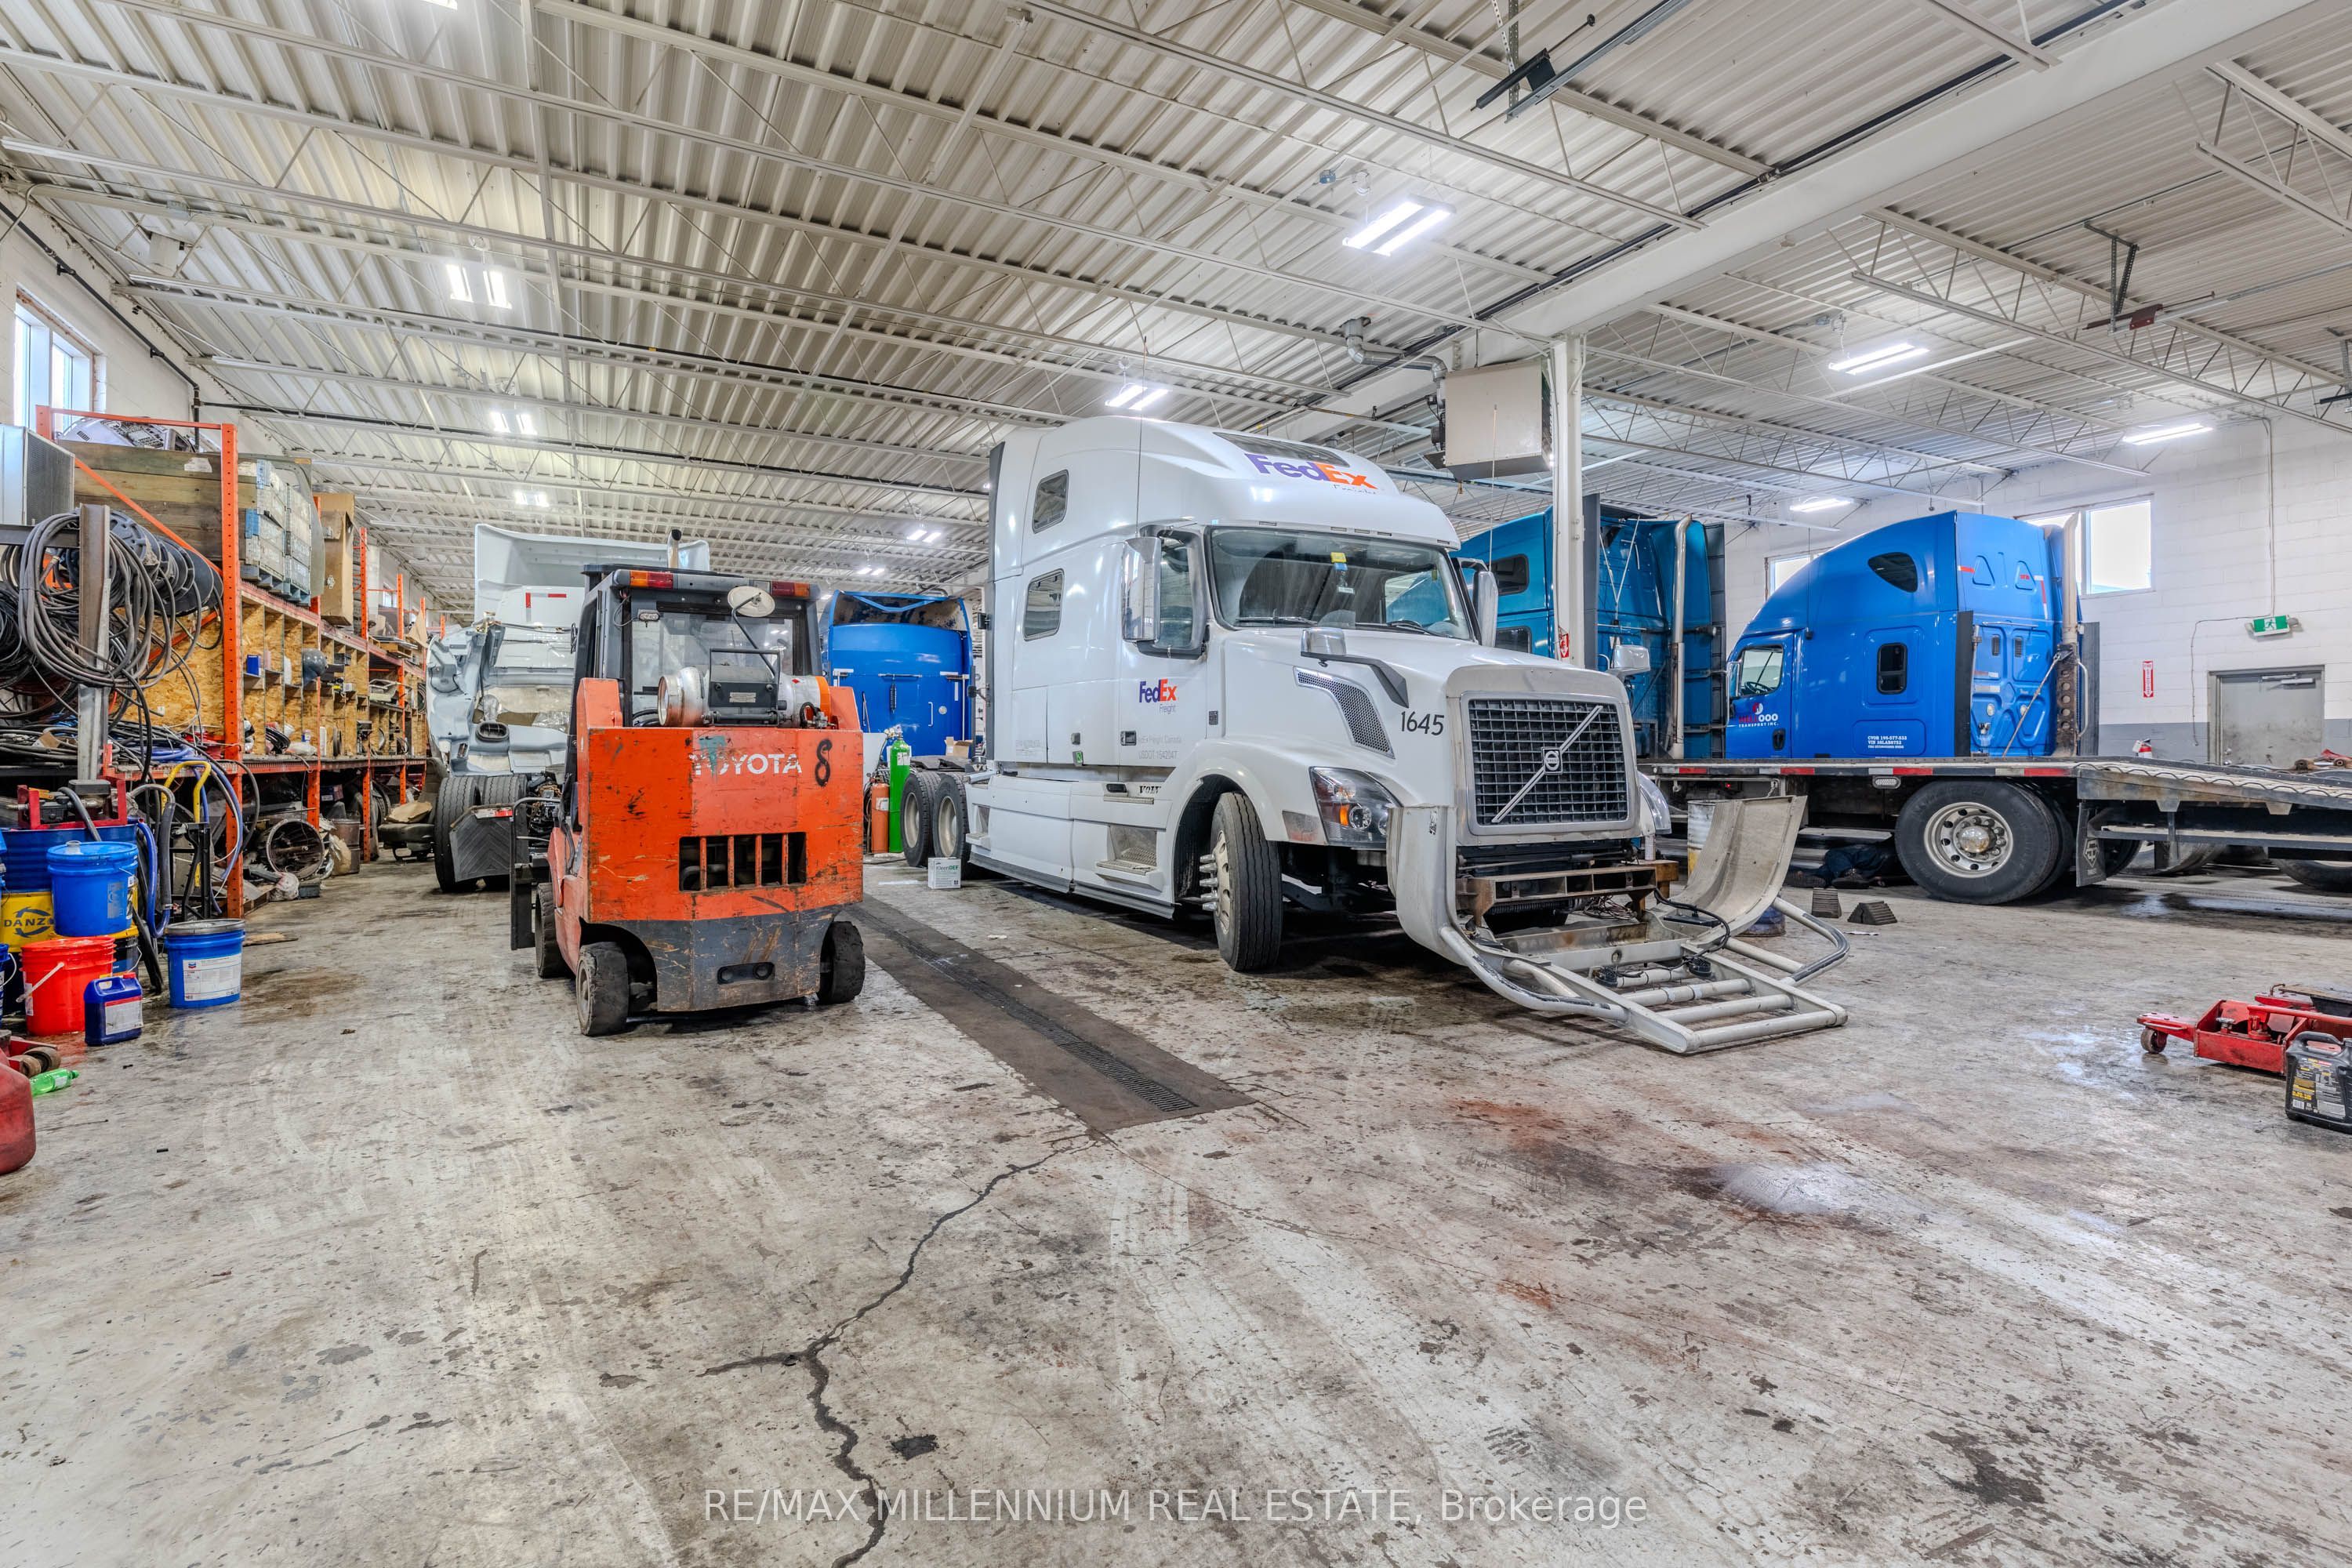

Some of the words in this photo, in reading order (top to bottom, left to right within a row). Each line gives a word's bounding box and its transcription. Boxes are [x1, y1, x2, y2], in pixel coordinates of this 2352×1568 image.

[1244, 452, 1378, 490] FedEx
[1139, 678, 1177, 702] FedEx
[1401, 711, 1445, 735] 1645
[815, 739, 833, 787] 8
[1139, 786, 1162, 794] VOLV
